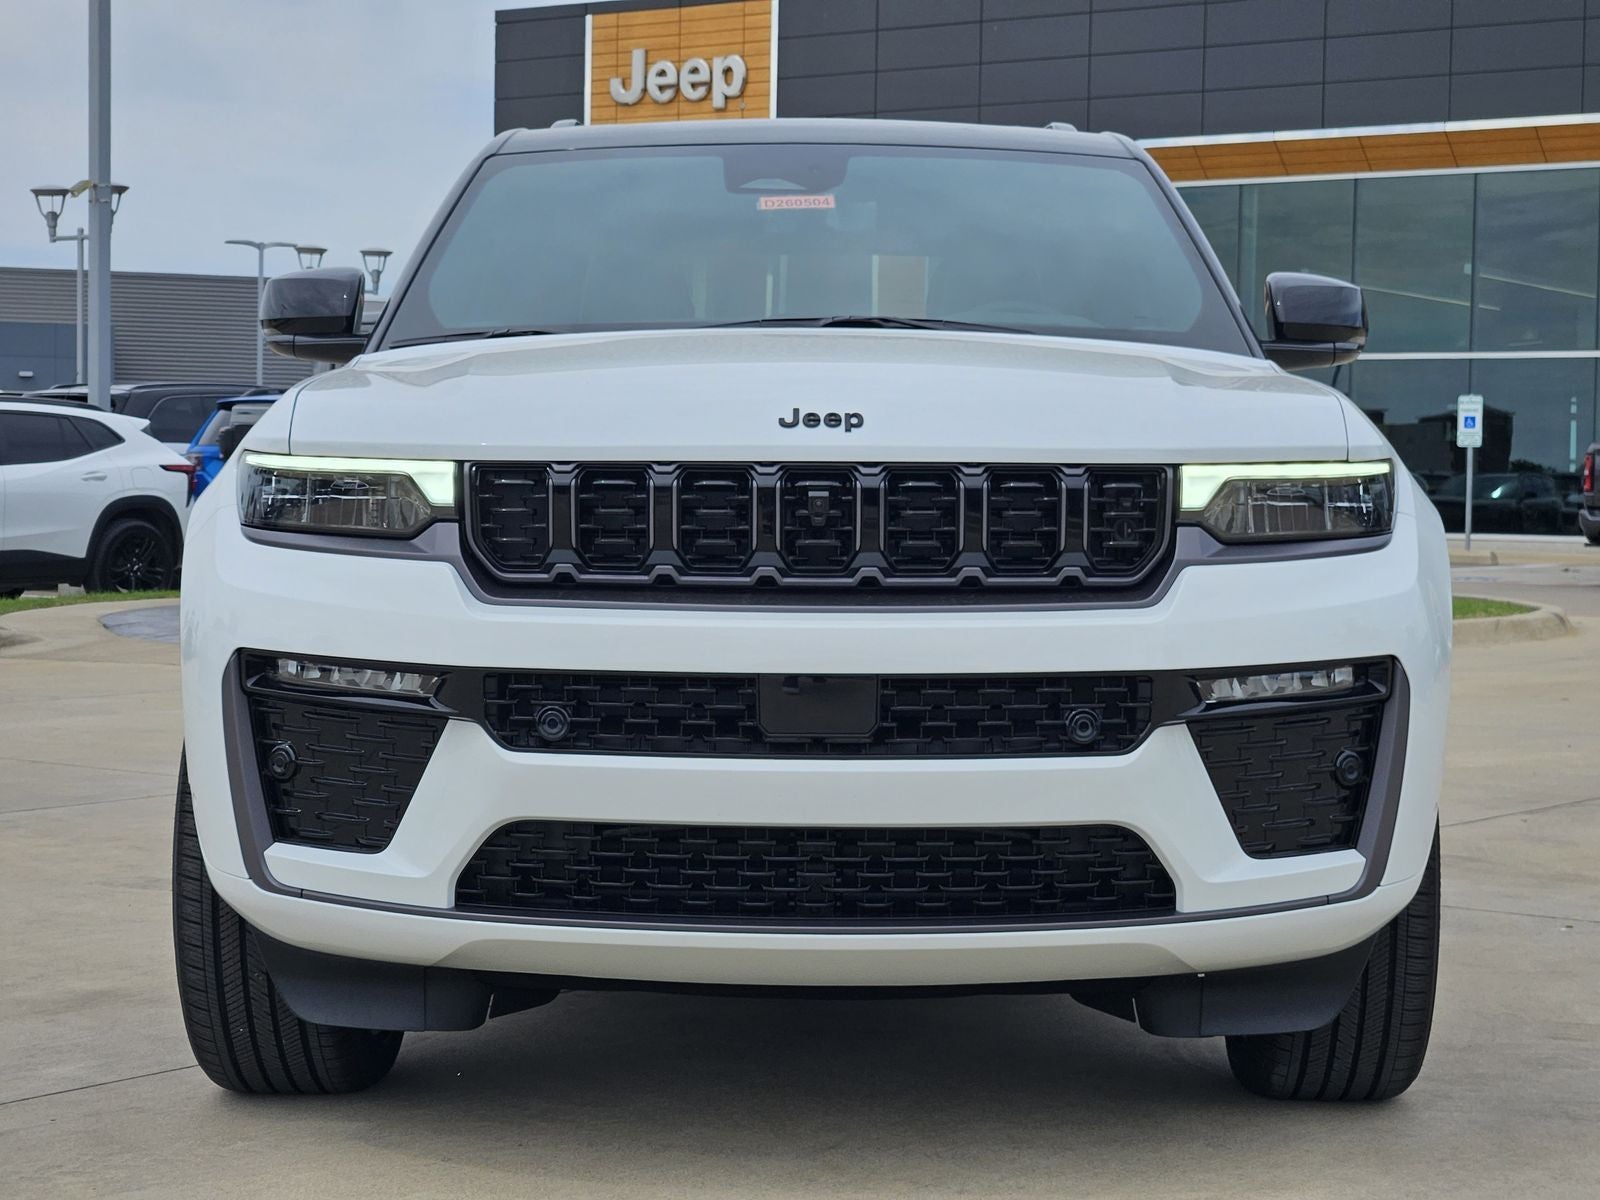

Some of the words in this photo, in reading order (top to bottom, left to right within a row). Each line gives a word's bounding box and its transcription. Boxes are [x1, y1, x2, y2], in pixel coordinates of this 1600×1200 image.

[609, 48, 746, 110] Jeep
[763, 197, 831, 209] D260504
[778, 407, 864, 433] Jeep
